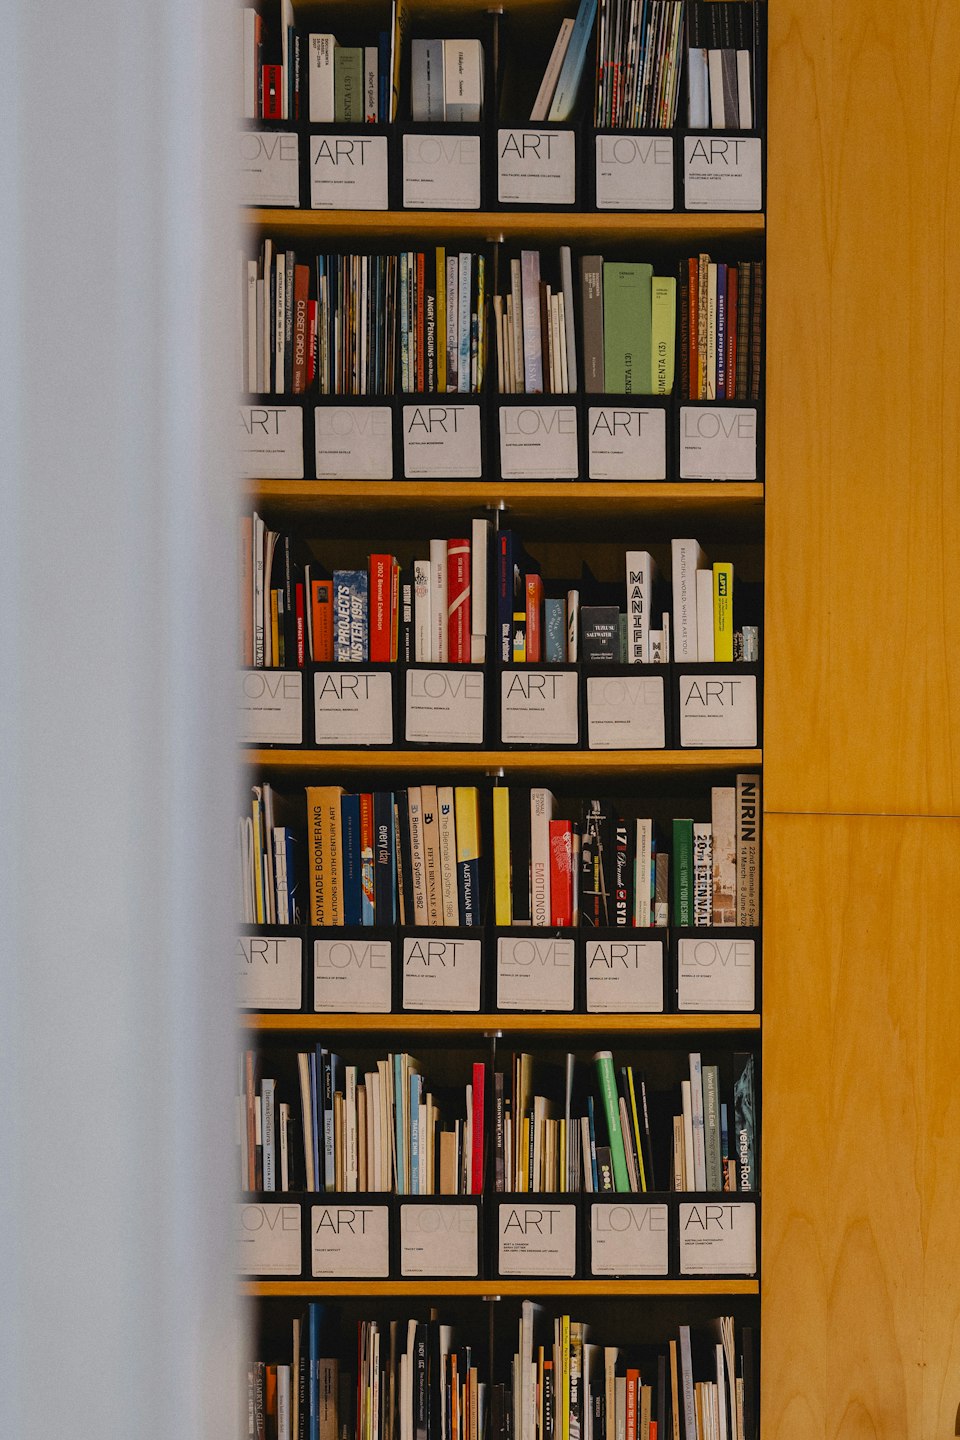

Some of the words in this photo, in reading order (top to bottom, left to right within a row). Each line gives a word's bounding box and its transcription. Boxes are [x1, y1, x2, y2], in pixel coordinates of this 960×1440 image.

[344, 75, 352, 91] (13)
[367, 89, 375, 108] guide
[240, 134, 297, 161] OVE
[314, 139, 372, 166] ART
[406, 139, 476, 165] LOVE
[500, 133, 559, 160] ART
[600, 138, 672, 165] LOVE
[689, 139, 747, 166] ART
[295, 300, 306, 333] CLOSET
[295, 333, 304, 366] CIRCUS
[526, 306, 537, 382] ORIENTALISM
[658, 341, 667, 357] (13)
[624, 352, 633, 367] (13)
[318, 409, 387, 437] LOVE
[407, 407, 465, 433] ART
[503, 409, 576, 436] LOVE
[591, 411, 649, 437] ART
[684, 412, 755, 439] LOVE
[402, 585, 411, 605] DESTROY
[719, 574, 727, 596] APT9
[338, 585, 350, 645] PROJECTS
[351, 596, 362, 619] 1997
[242, 673, 301, 700] OVE
[319, 674, 376, 700] ART
[410, 672, 481, 700] LOVE
[506, 674, 564, 700] ART
[590, 680, 661, 707] LOVE
[684, 681, 742, 707] ART
[741, 782, 756, 842] NIRIN
[313, 806, 323, 871] BOOMERANG
[377, 825, 389, 849] every
[411, 817, 420, 850] Biennale
[442, 831, 450, 862] Biennale
[697, 834, 708, 862] 20TH
[412, 862, 422, 889] Sydney
[616, 851, 627, 888] Biennale
[428, 870, 436, 907] BIENNALE
[444, 872, 452, 898] Sydney
[463, 863, 472, 910] AUSTRALIAN
[616, 902, 627, 928] SYD
[680, 901, 689, 923] DESIRE
[316, 942, 387, 969] LOVE
[406, 941, 465, 967] ART
[500, 940, 571, 967] LOVE
[589, 943, 647, 969] ART
[681, 941, 751, 967] LOVE
[707, 1090, 715, 1114] Without
[707, 1128, 717, 1165] Photography
[739, 1129, 750, 1164] versus
[601, 1165, 611, 1190] 2004
[315, 1209, 374, 1234] ART
[404, 1207, 476, 1234] LOVE
[503, 1209, 561, 1235] ART
[596, 1206, 666, 1232] LOVE
[684, 1205, 741, 1231] ART
[683, 1369, 691, 1400] HOWARD
